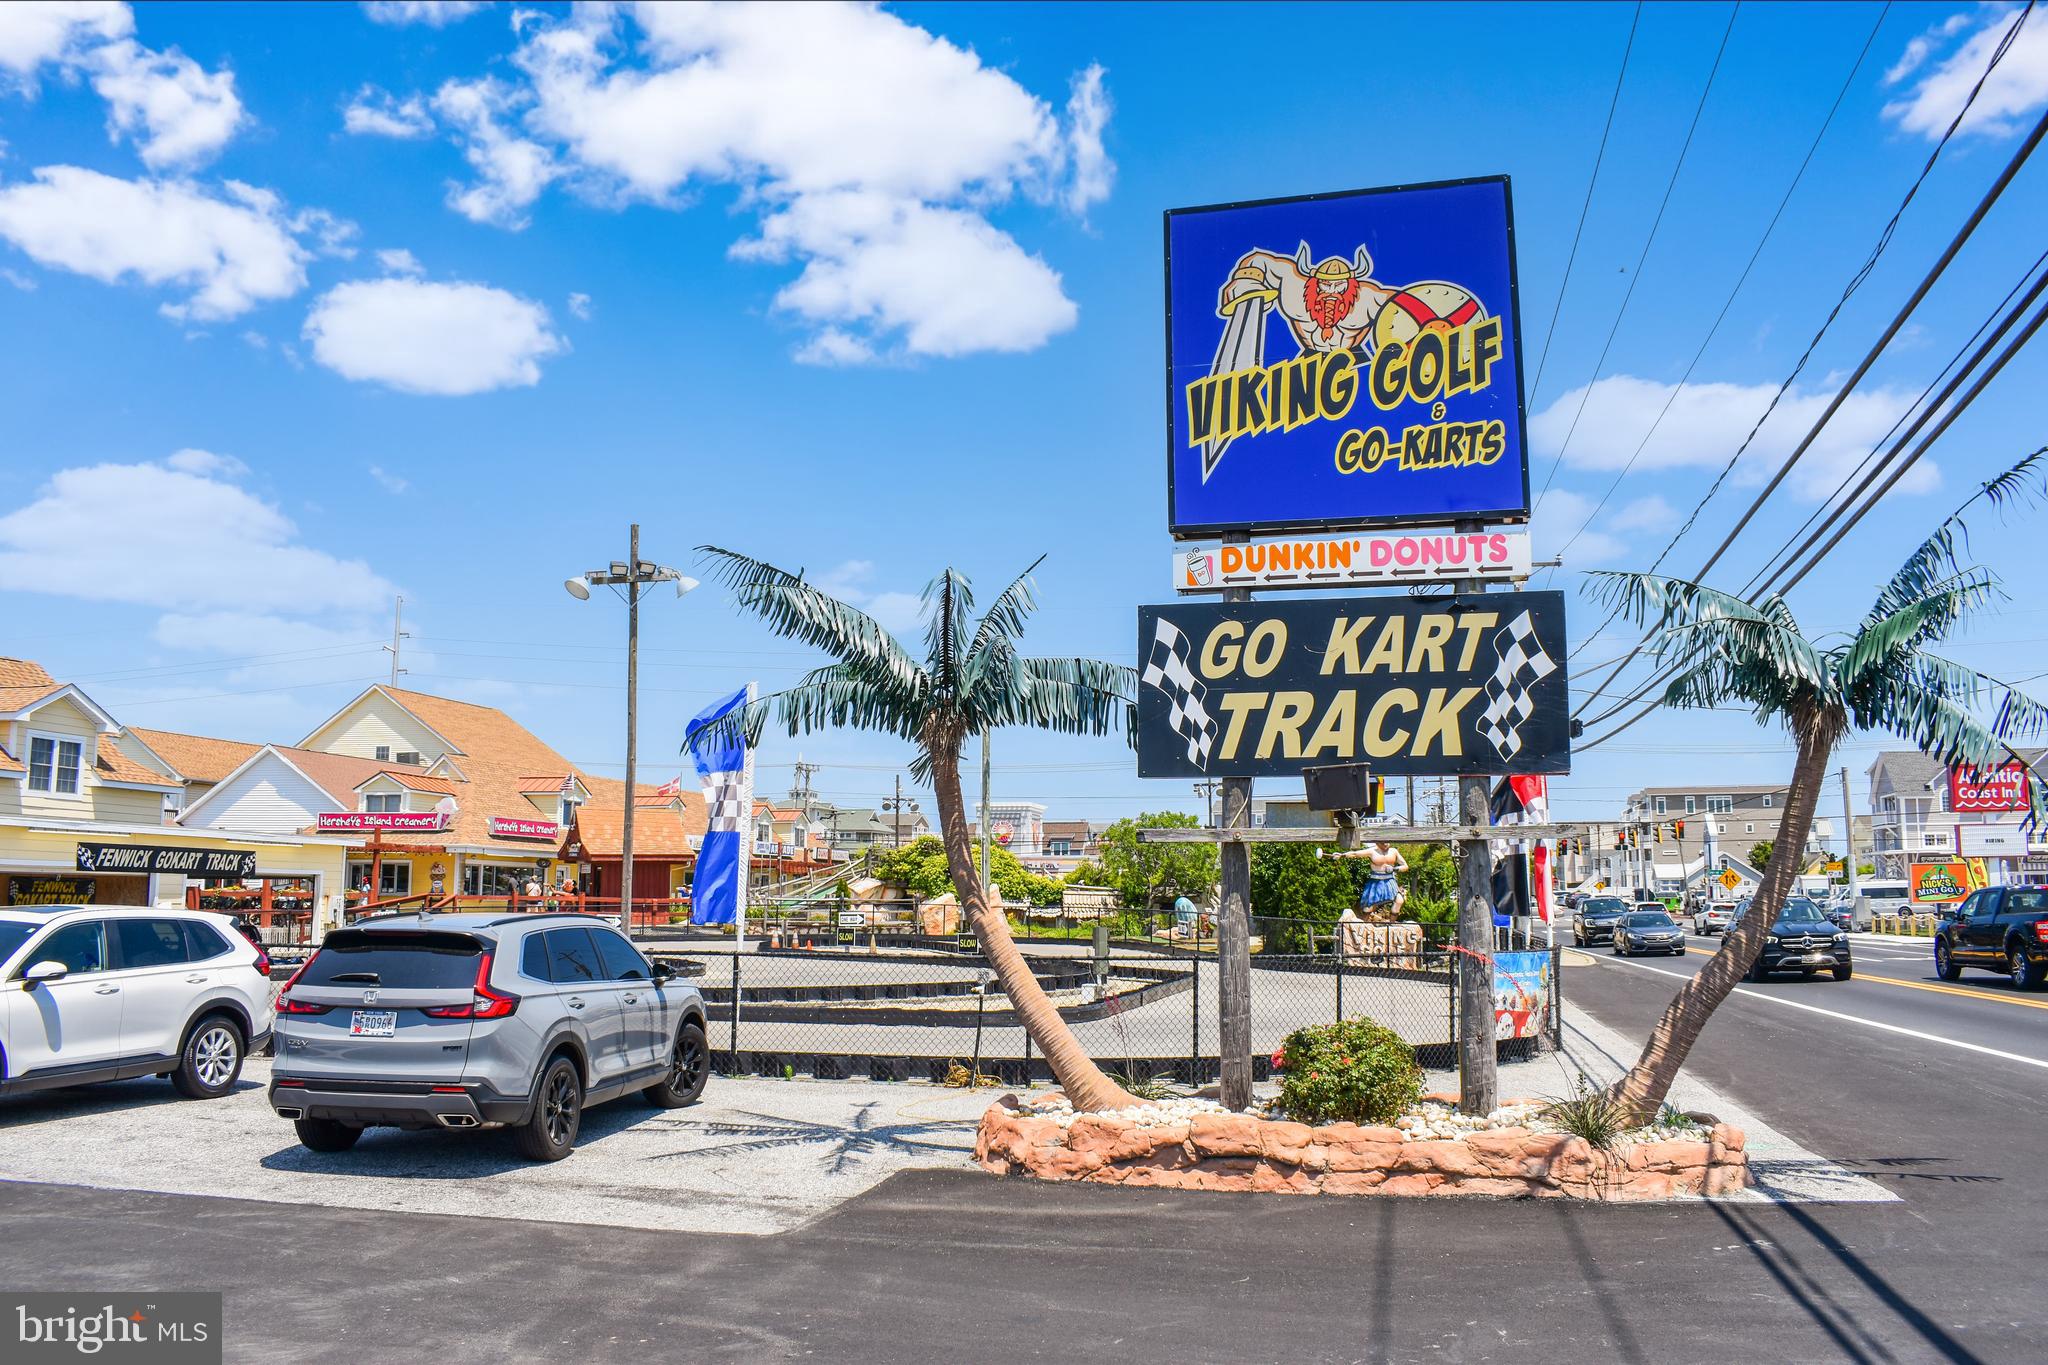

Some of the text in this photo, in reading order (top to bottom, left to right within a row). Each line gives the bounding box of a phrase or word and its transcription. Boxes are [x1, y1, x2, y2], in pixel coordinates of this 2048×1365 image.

[1186, 315, 1502, 448] VIKING GOLF
[1431, 402, 1446, 420] &
[1335, 420, 1505, 475] GO-KARTS
[1221, 533, 1508, 573] DUNKIN' DONUTS
[1200, 611, 1499, 679] GO KART
[1218, 687, 1483, 760] TRACK
[95, 848, 242, 871] FENWICK GOKART TRACK
[32, 881, 77, 893] FENWICK
[1918, 887, 1938, 896] MINI
[1921, 878, 1951, 889] NICK'S
[58, 893, 92, 905] TRACK
[839, 933, 853, 941] SLOW
[959, 939, 977, 948] SLOW
[1349, 924, 1417, 946] VIKING
